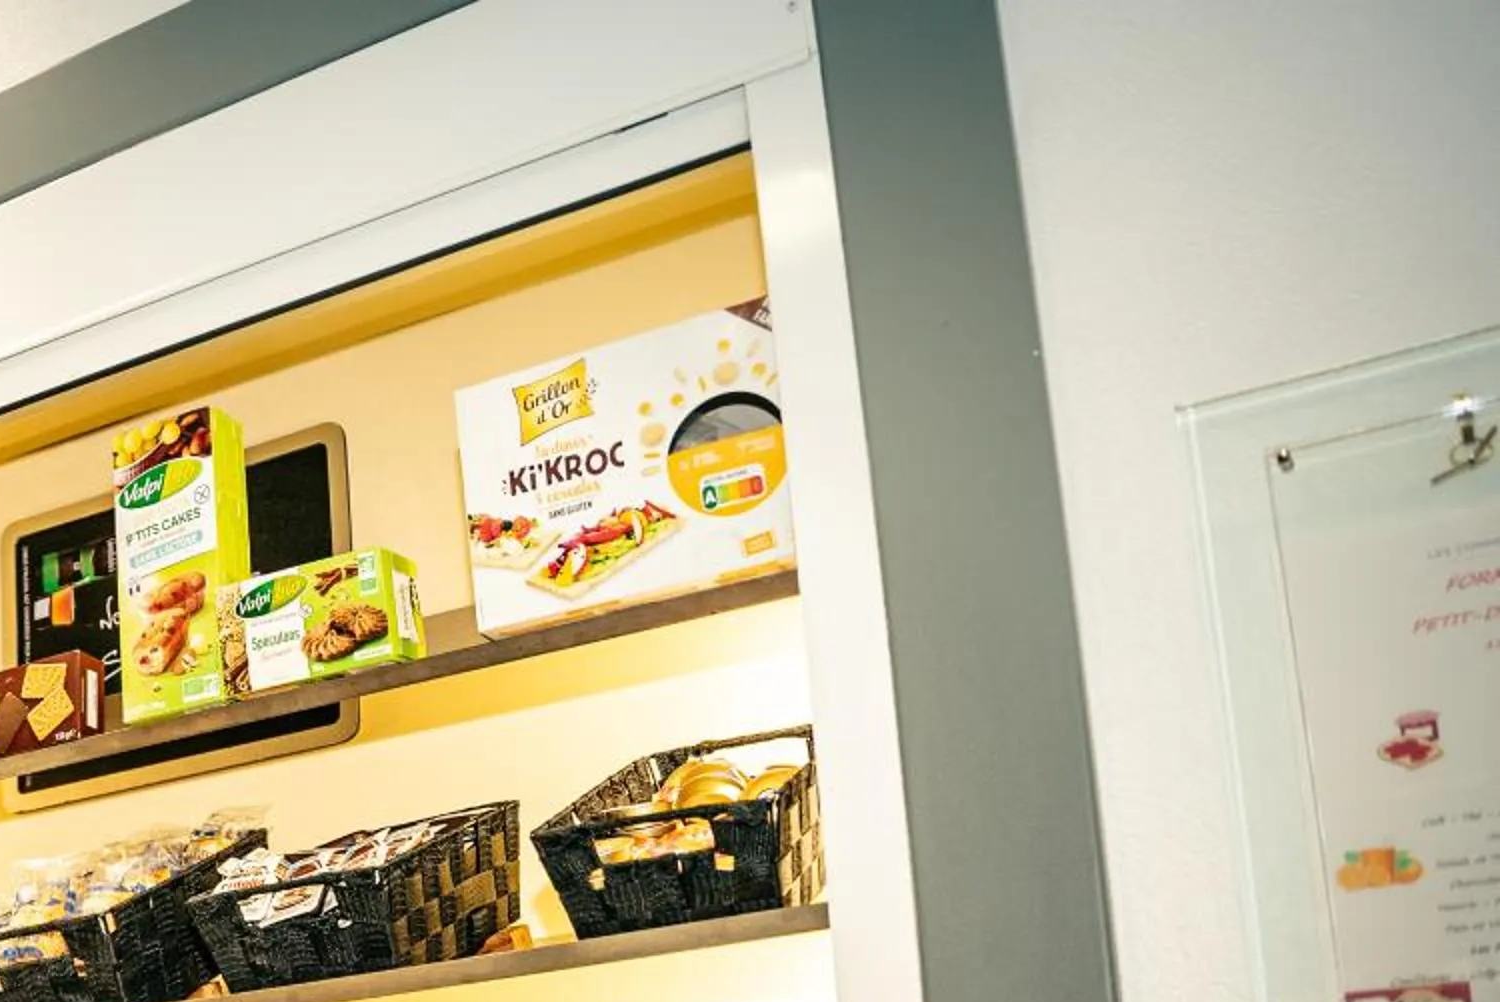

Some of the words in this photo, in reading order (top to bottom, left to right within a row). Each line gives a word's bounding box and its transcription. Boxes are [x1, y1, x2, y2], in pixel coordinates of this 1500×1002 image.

[522, 376, 581, 412] Grillon
[535, 399, 573, 425] d'Or
[508, 440, 625, 497] Ki'KROC
[123, 473, 165, 507] Valpi
[161, 507, 202, 531] CAKES
[237, 588, 272, 617] Valpi
